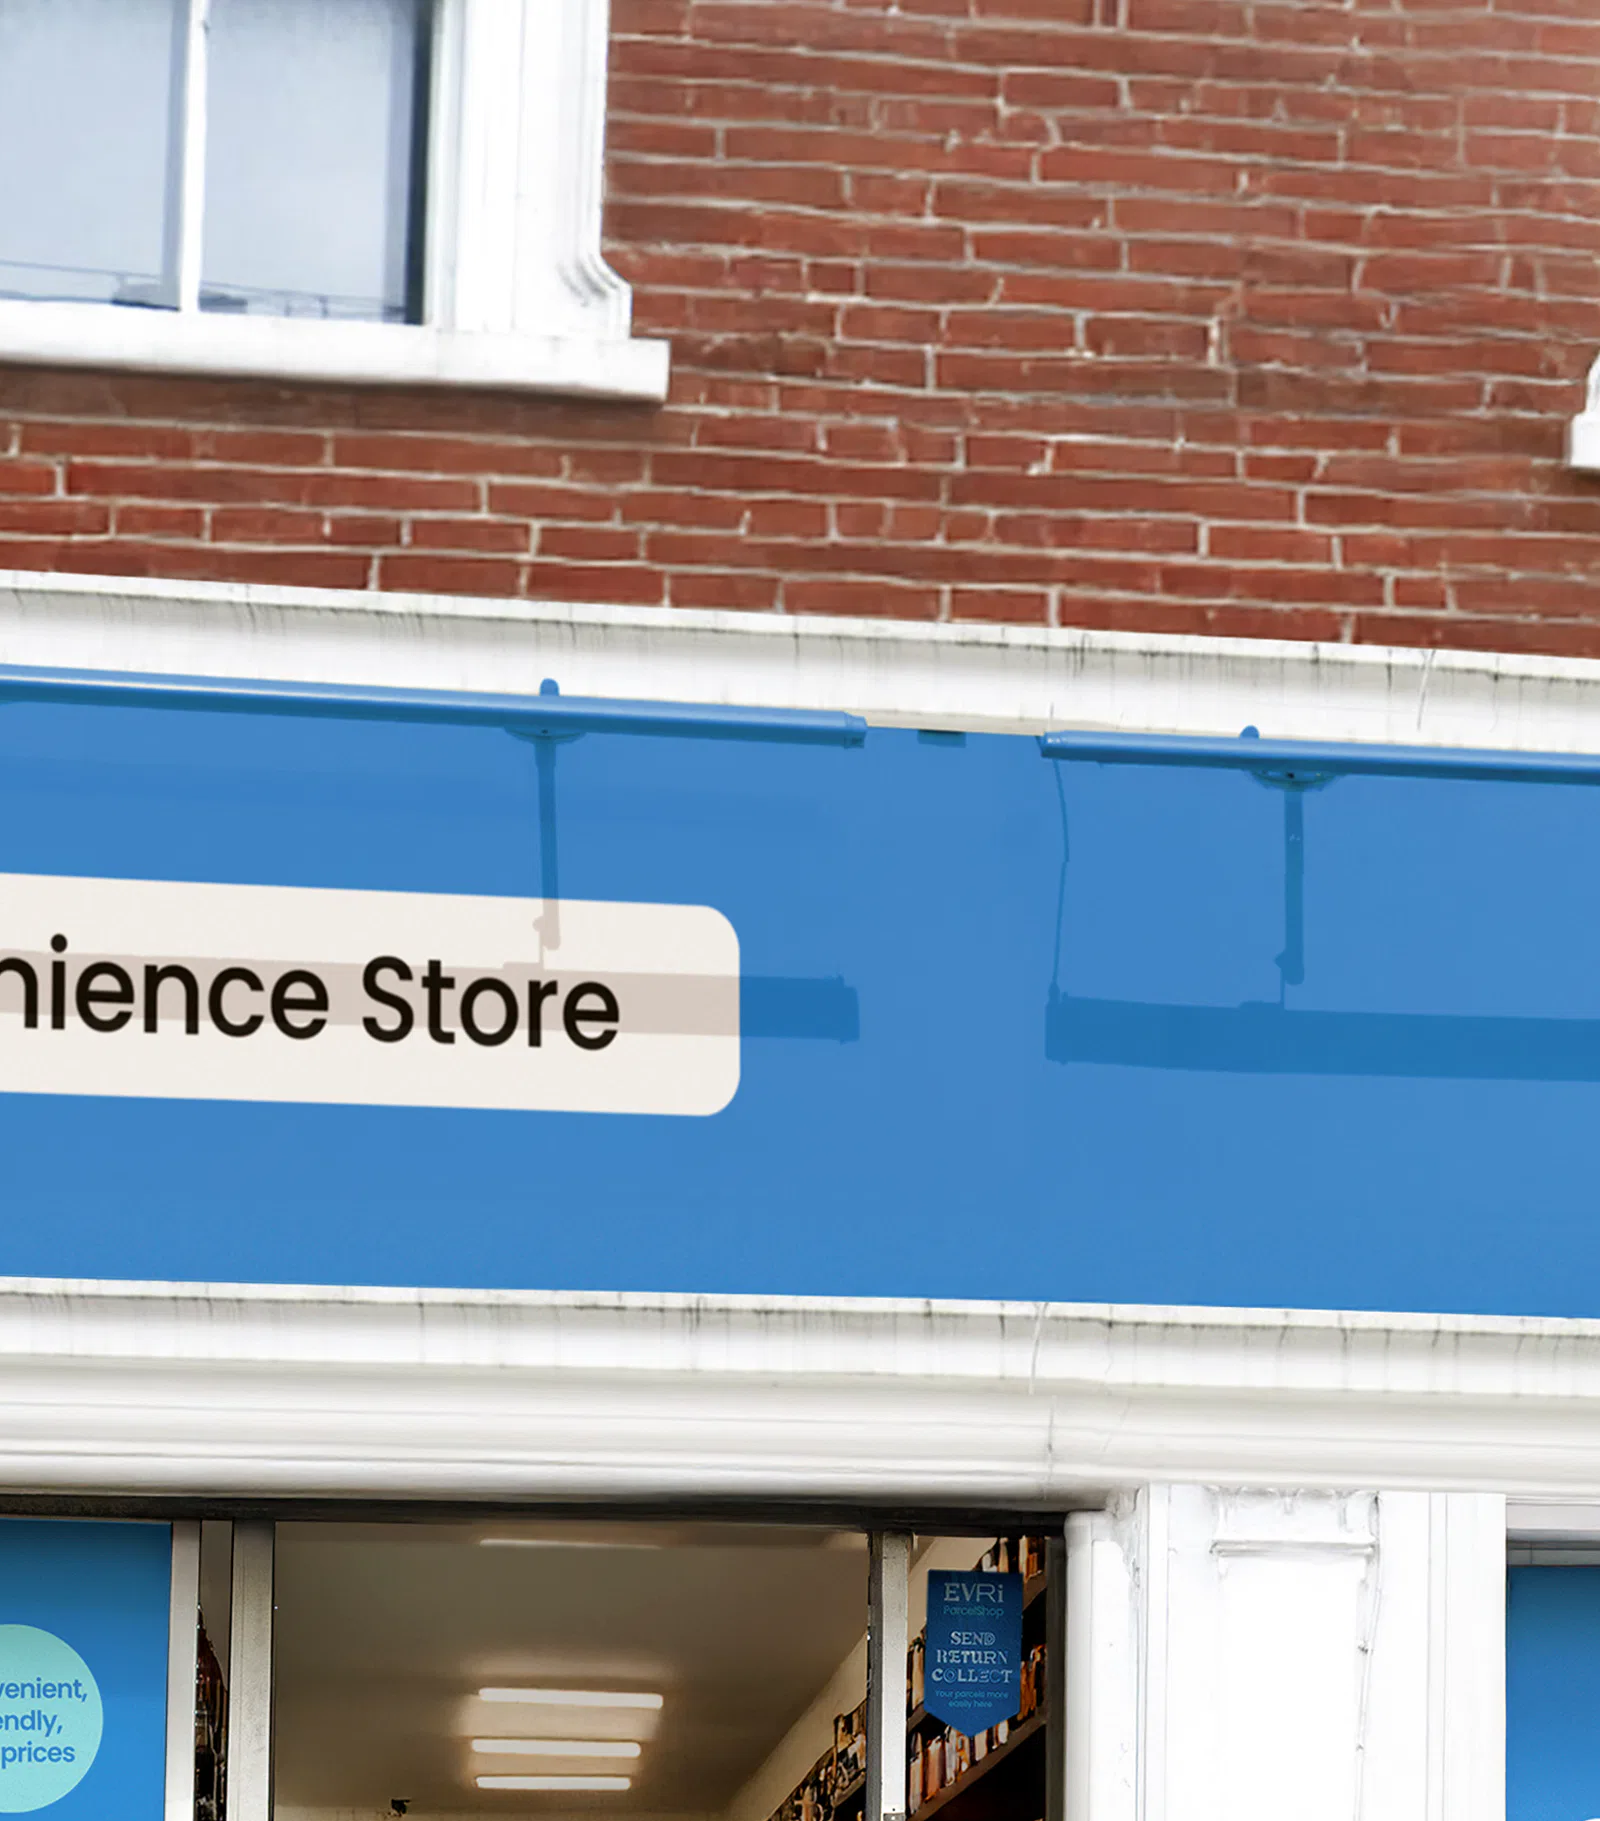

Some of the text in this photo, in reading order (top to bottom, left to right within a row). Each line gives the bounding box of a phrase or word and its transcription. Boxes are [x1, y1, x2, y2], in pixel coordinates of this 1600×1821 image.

[362, 956, 621, 1051] Store
[944, 1582, 1004, 1603] EVRi
[950, 1631, 996, 1646] SEND
[937, 1649, 1009, 1665] RETURN
[931, 1668, 1013, 1684] COLLECT
[0, 1741, 76, 1769] prices
